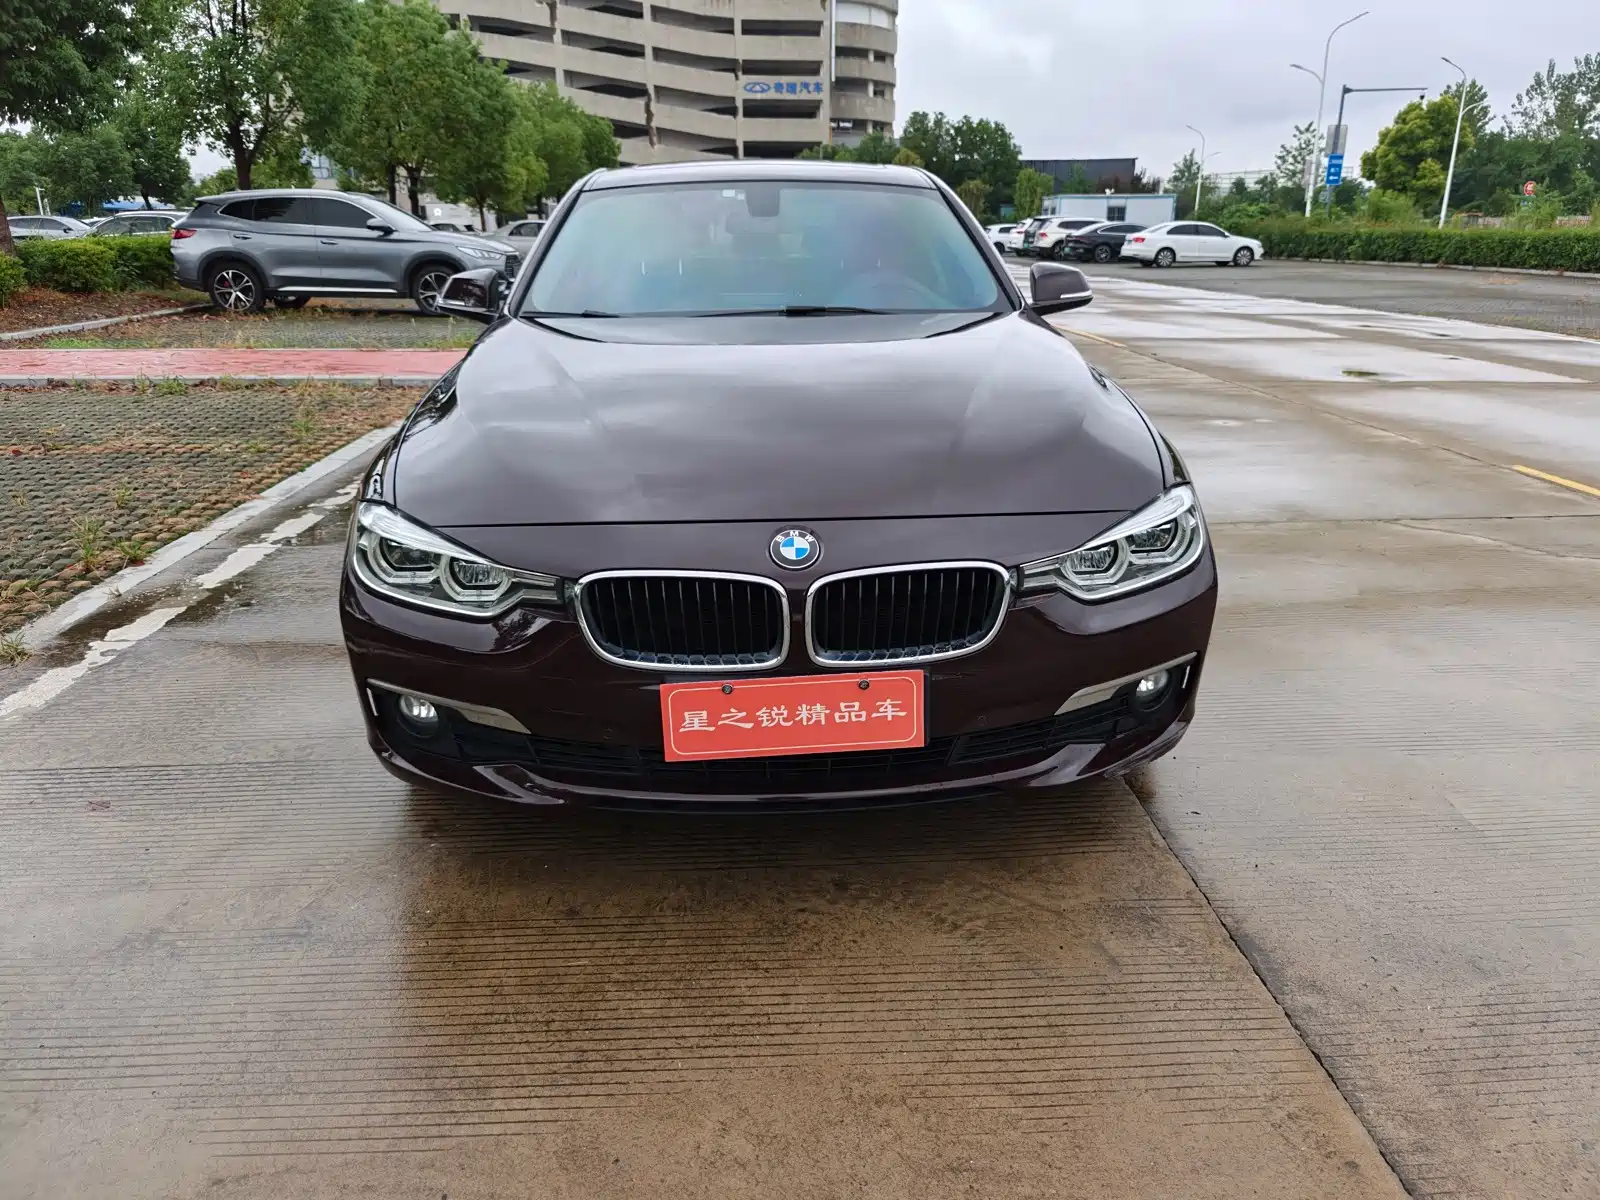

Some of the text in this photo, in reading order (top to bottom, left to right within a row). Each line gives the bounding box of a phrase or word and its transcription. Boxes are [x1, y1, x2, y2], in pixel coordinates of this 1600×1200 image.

[775, 530, 815, 542] BMW
[679, 698, 907, 732] 星之锐精品车
